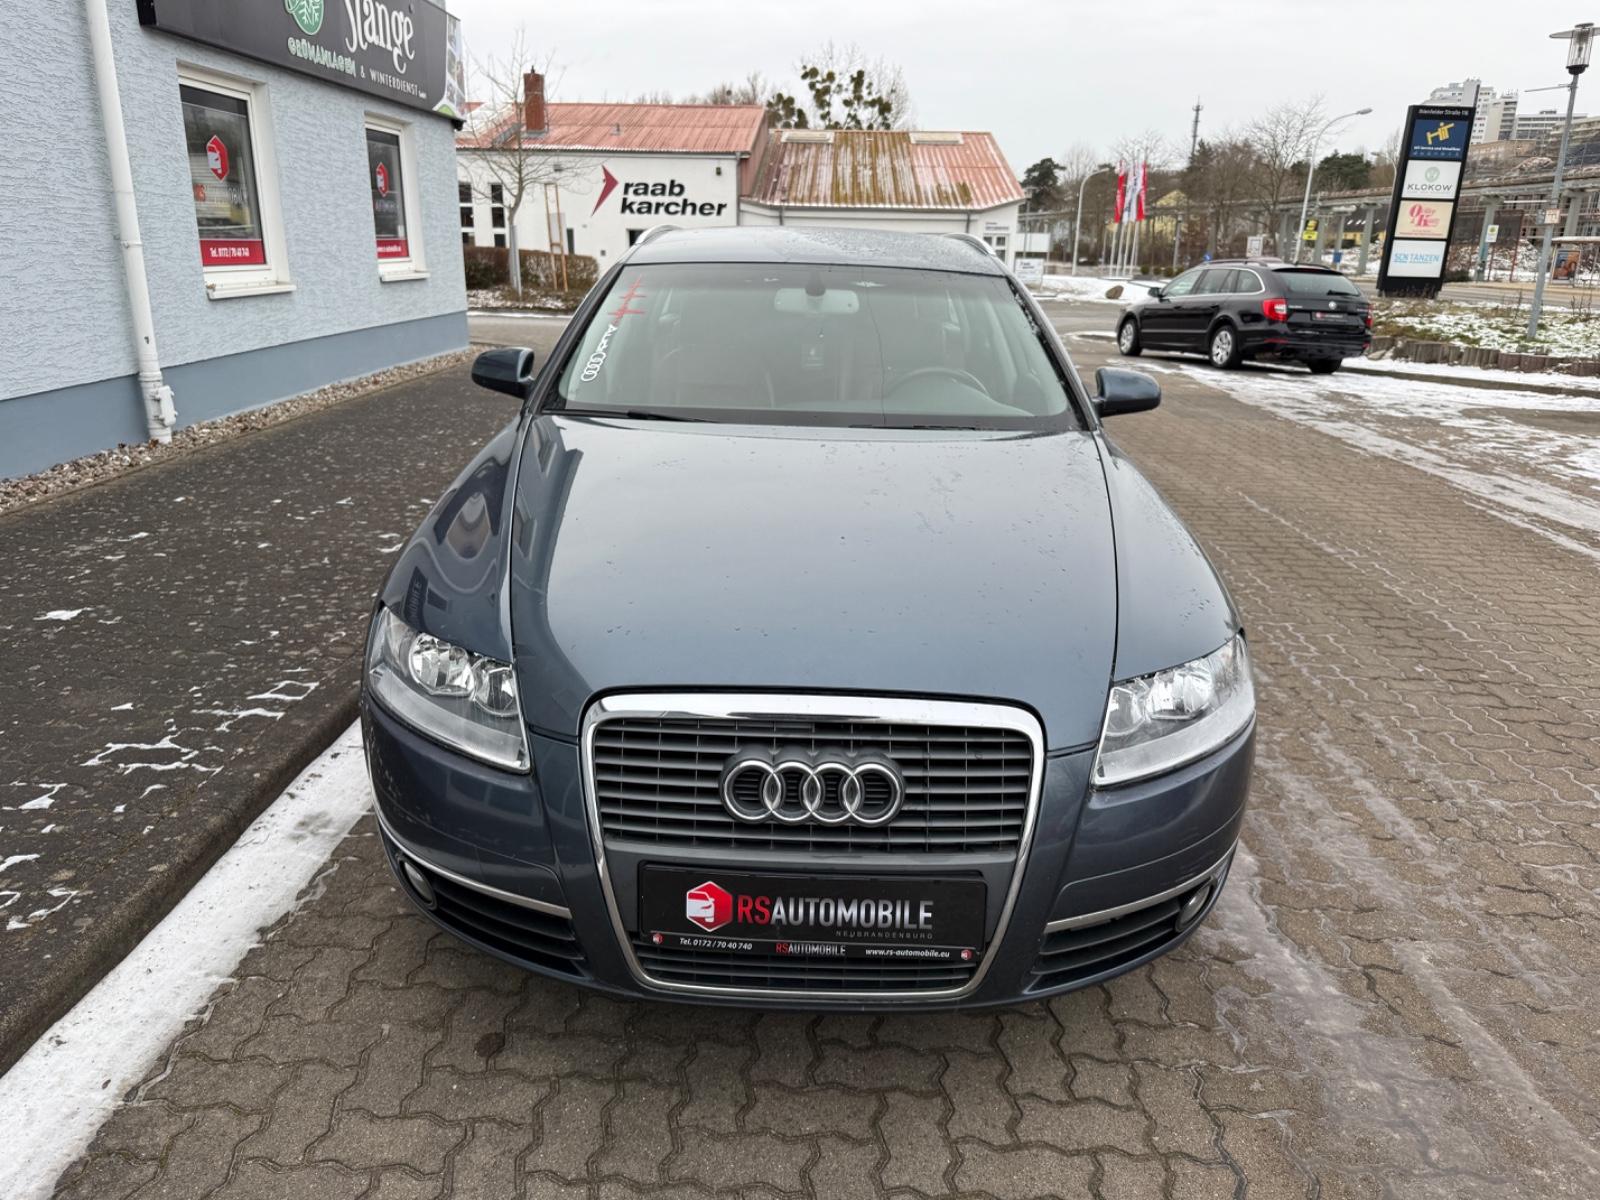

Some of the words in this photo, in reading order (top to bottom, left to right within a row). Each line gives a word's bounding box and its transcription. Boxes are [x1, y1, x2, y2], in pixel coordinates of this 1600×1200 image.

[360, 65, 366, 79] &
[369, 68, 419, 96] WINTERDIENST
[623, 179, 685, 197] raab
[1407, 183, 1453, 192] KLOKOW
[620, 198, 727, 216] karcher
[1409, 254, 1440, 262] TANZEN
[737, 895, 934, 929] RSAUTOMOBILE
[835, 930, 934, 940] NEUBRANDENBURG
[680, 937, 692, 946] Tel.
[692, 938, 712, 948] 0172
[716, 940, 727, 949] 70
[727, 941, 737, 949] 40
[737, 942, 753, 950] 740
[865, 949, 950, 958] www.rs-automobile.eu
